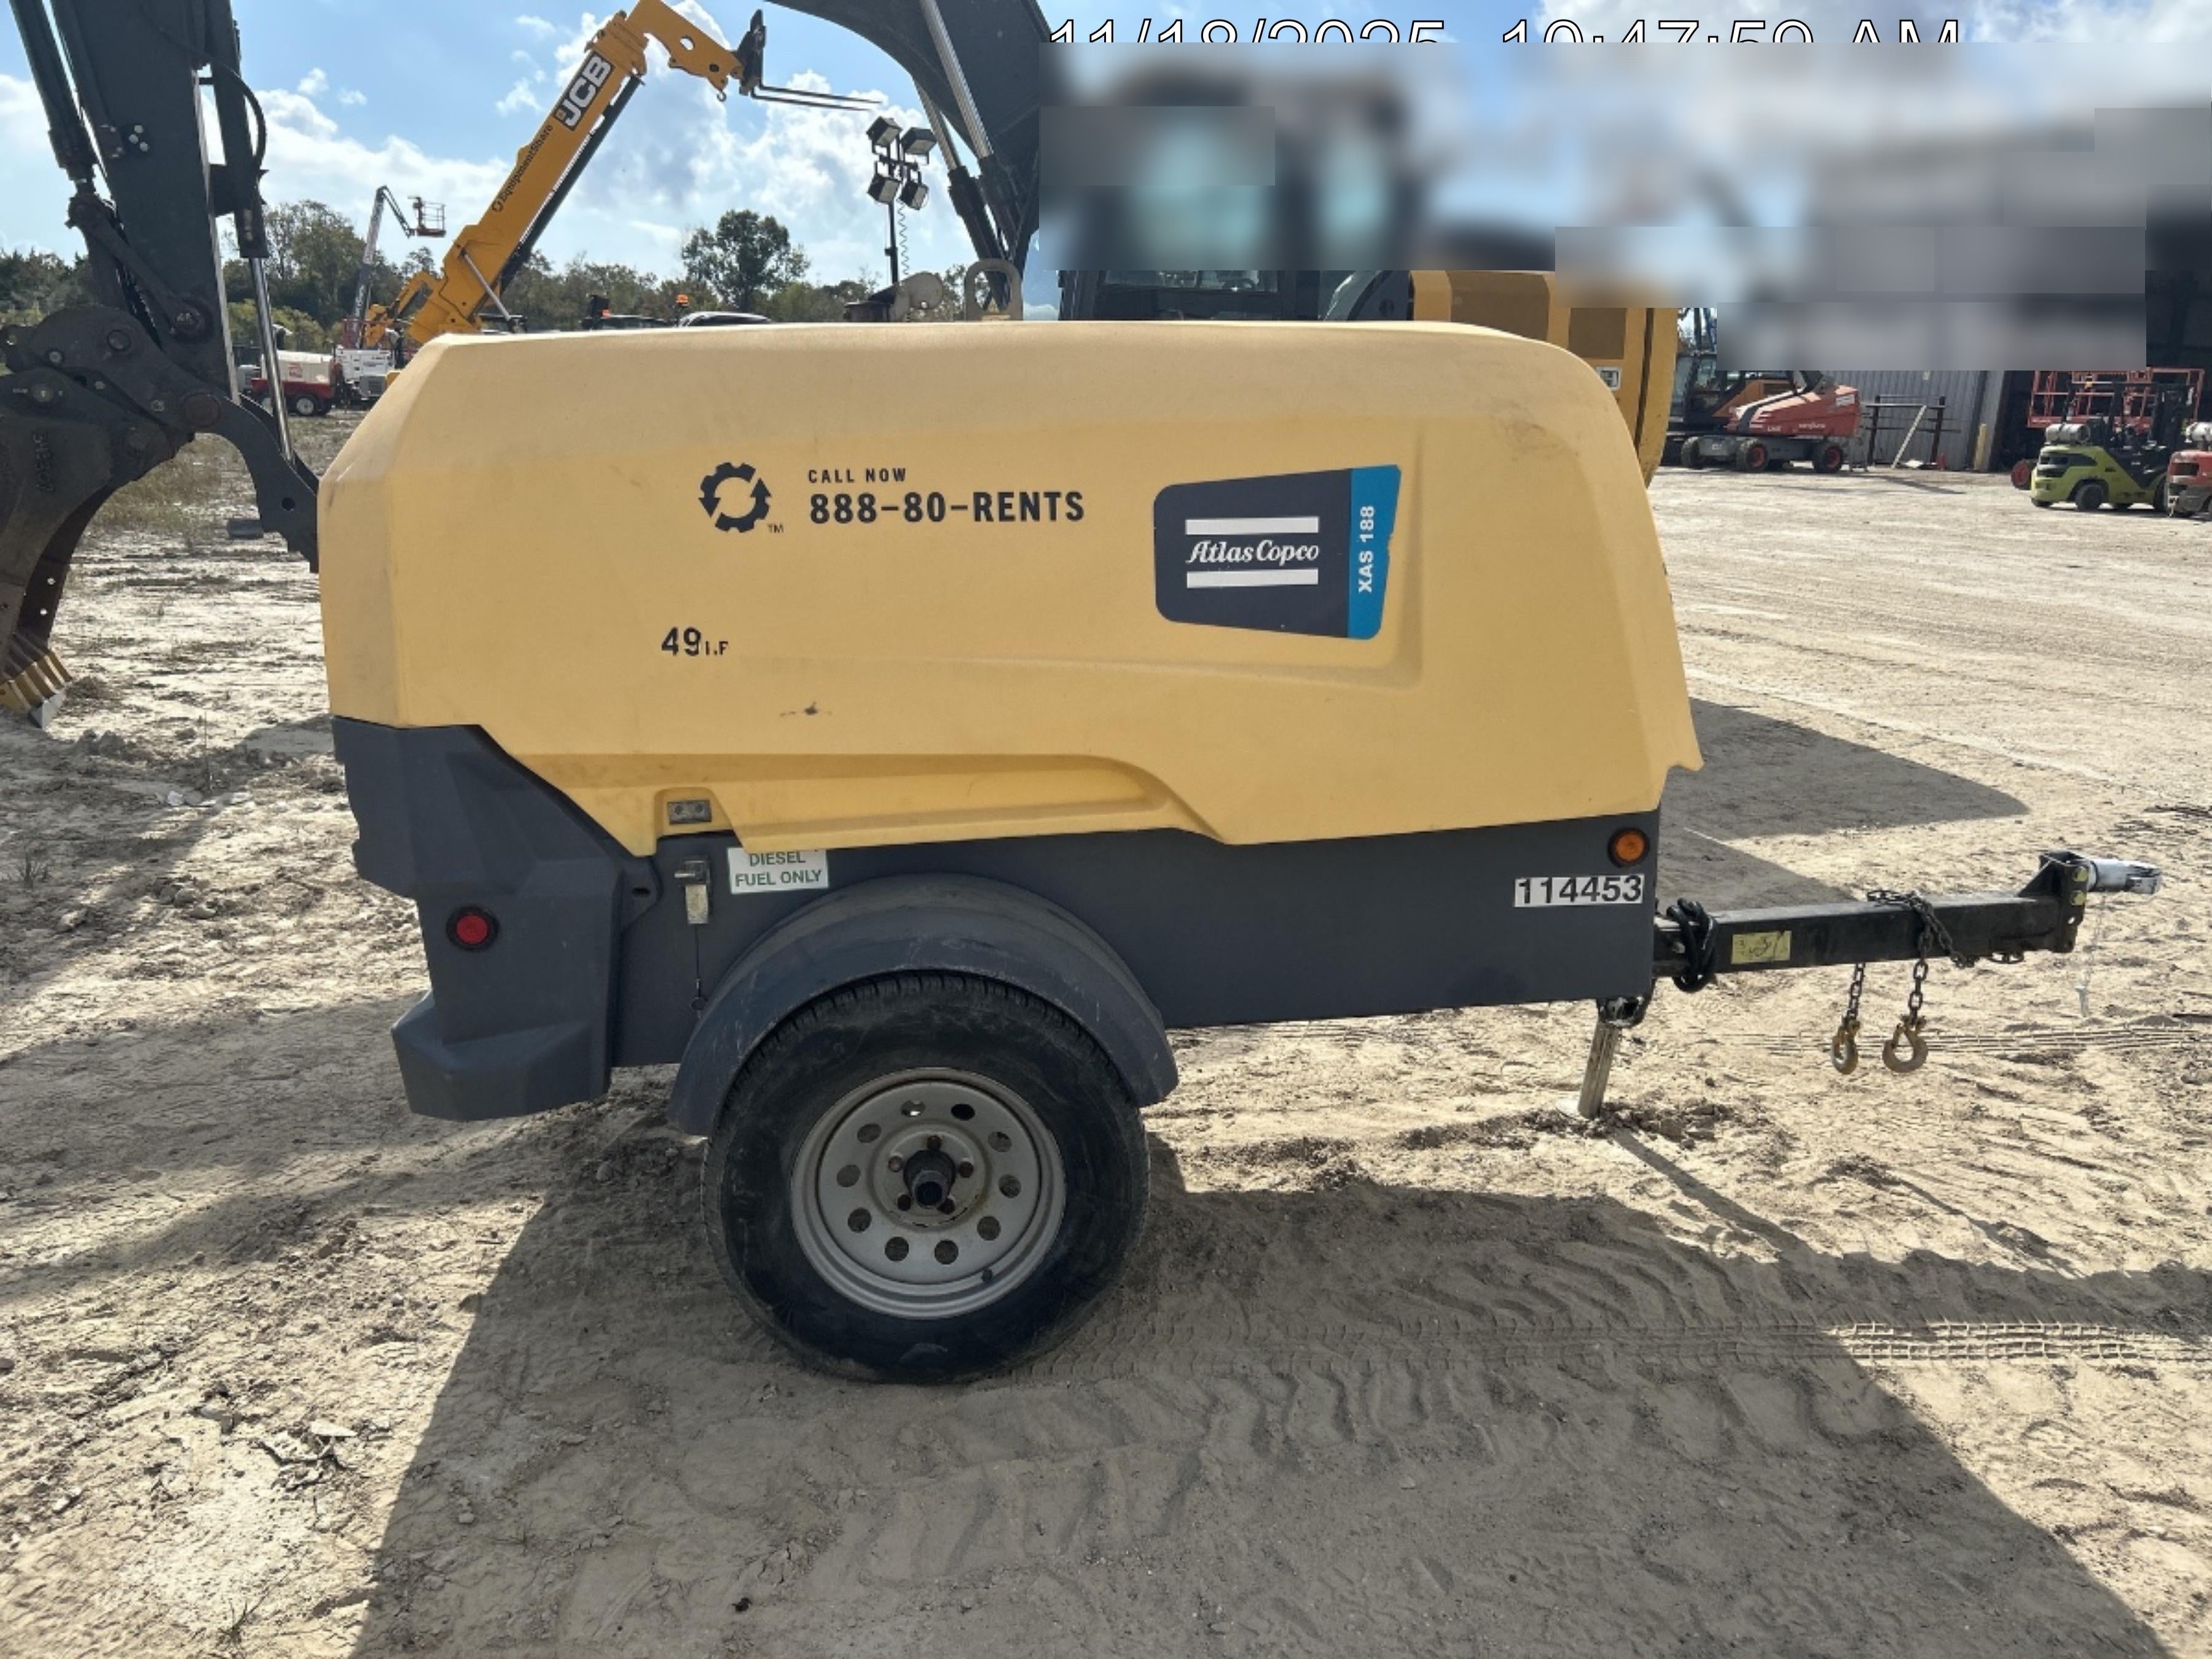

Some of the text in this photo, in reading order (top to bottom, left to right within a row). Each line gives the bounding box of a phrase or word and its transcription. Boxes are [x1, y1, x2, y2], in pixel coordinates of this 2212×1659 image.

[561, 55, 611, 127] JCB
[808, 468, 907, 484] CALL NOW
[809, 491, 1085, 524] 888-80-RENTS
[1185, 539, 1319, 567] Atlas Copco
[1358, 505, 1376, 594] XAS 188
[750, 850, 806, 867] DIESEL
[735, 869, 823, 888] FUEL ONLY
[1518, 874, 1642, 904] 114453
